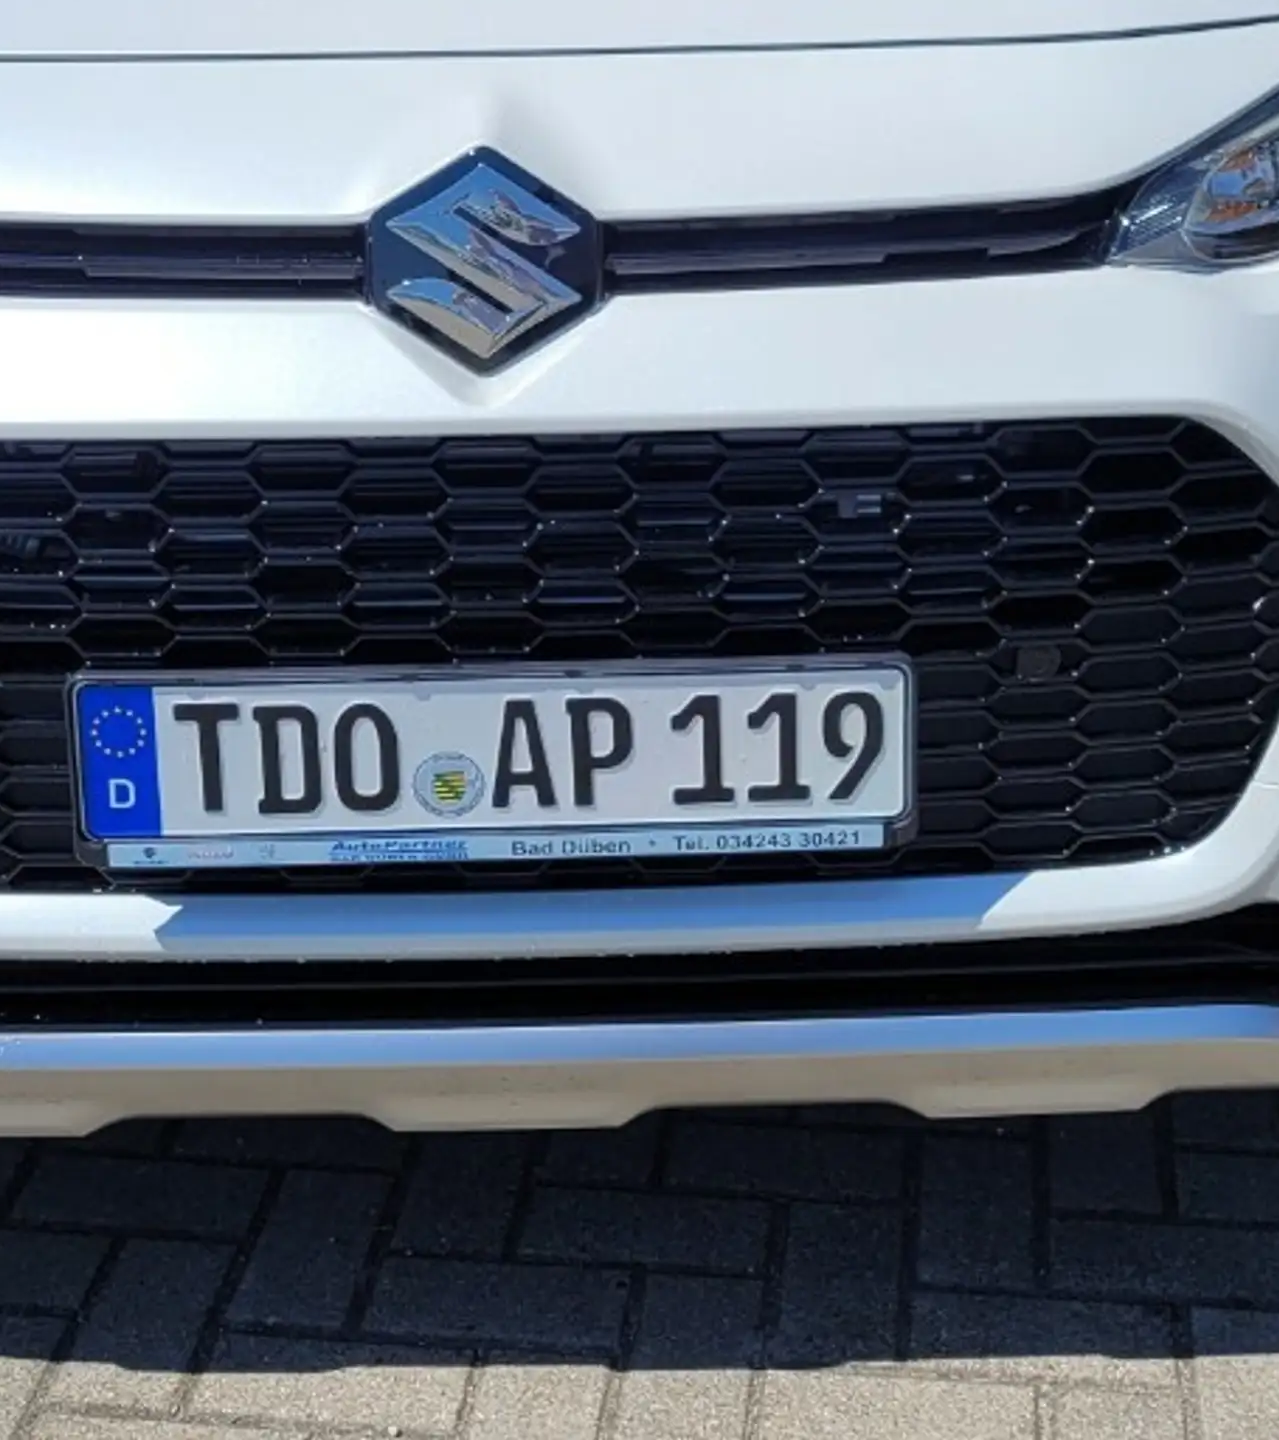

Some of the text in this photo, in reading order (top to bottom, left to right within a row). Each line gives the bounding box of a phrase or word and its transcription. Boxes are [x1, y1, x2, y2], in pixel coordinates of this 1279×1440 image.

[107, 691, 884, 815] D TDO AP 119
[511, 839, 553, 855] Bad
[561, 837, 631, 854] Düben
[673, 835, 709, 851] Tel.
[716, 833, 792, 850] 034243
[796, 830, 861, 846] 30421
